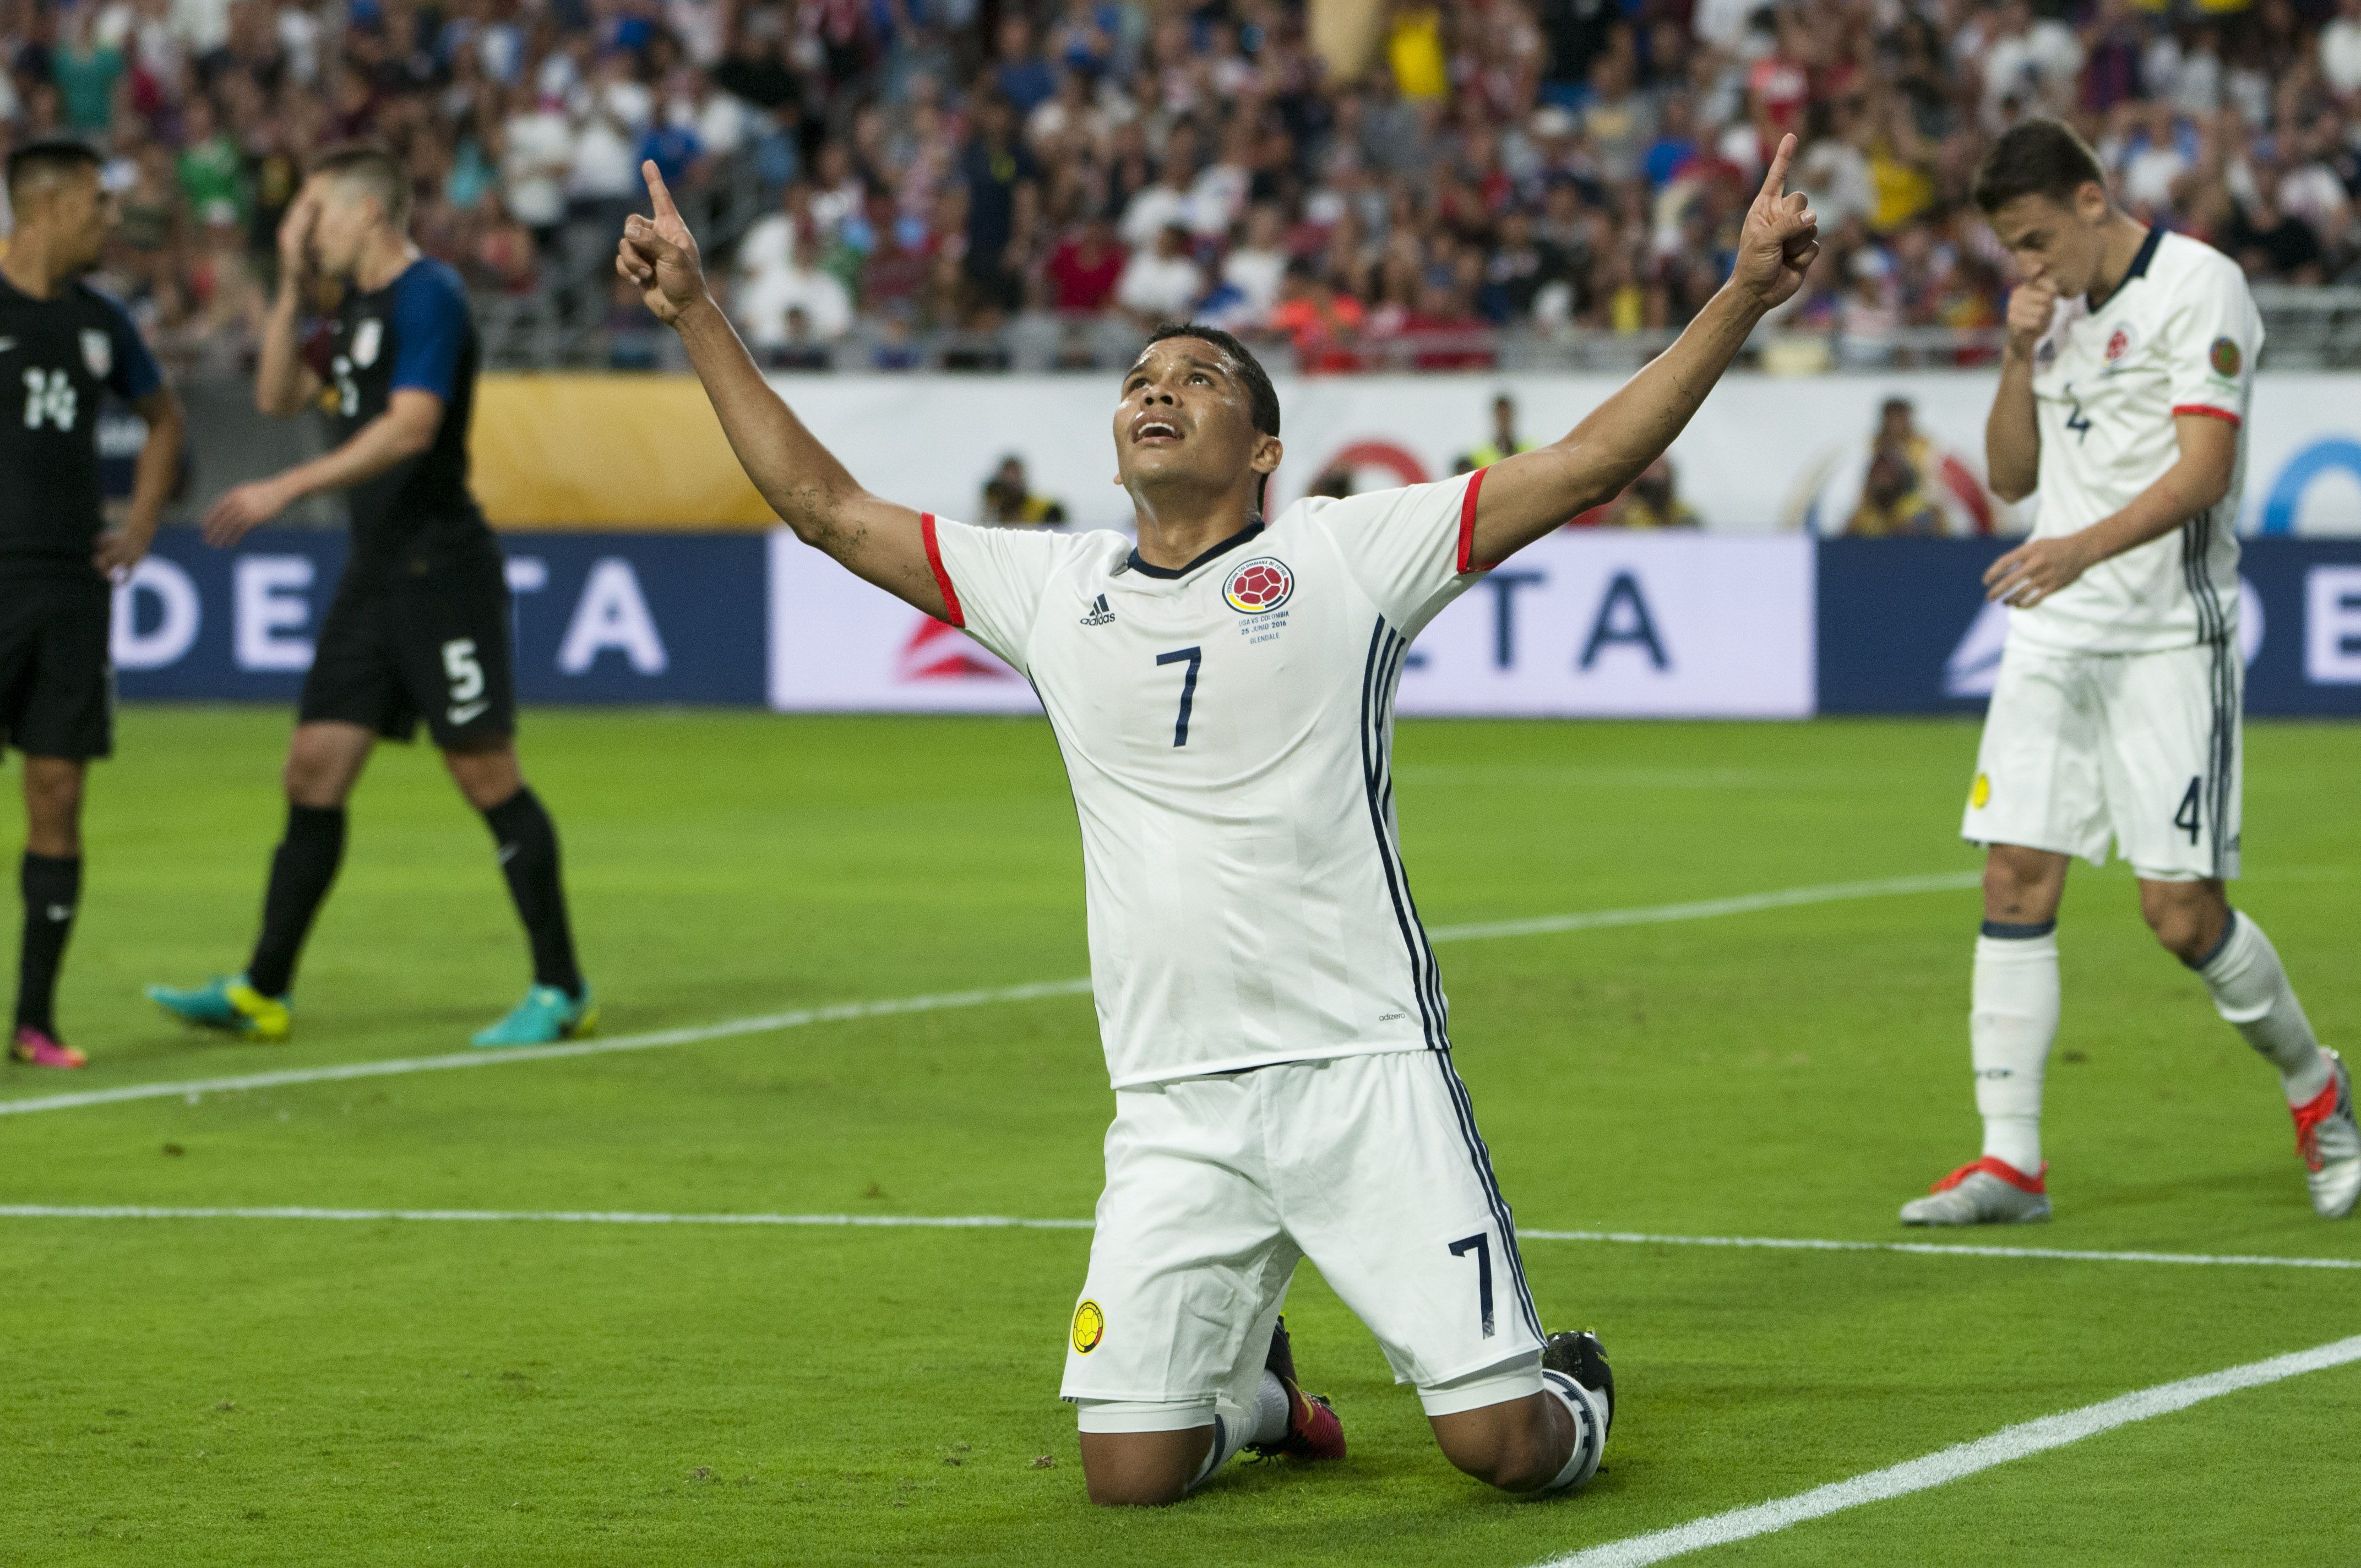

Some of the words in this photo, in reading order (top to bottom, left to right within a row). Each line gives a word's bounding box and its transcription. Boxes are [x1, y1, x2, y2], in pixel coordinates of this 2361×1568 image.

[23, 366, 78, 432] 14
[110, 555, 668, 674] DEA
[1080, 612, 1116, 626] adidas
[1250, 633, 1280, 644] GLENDALE
[1252, 623, 1269, 633] JUNIO
[1272, 620, 1287, 629] 2016
[1260, 610, 1289, 622] COLOMBIA
[442, 639, 485, 703] 5
[1156, 646, 1202, 747] 7
[2173, 776, 2201, 845] 4
[1379, 1013, 1406, 1021] adizero
[1448, 1232, 1495, 1340] 7
